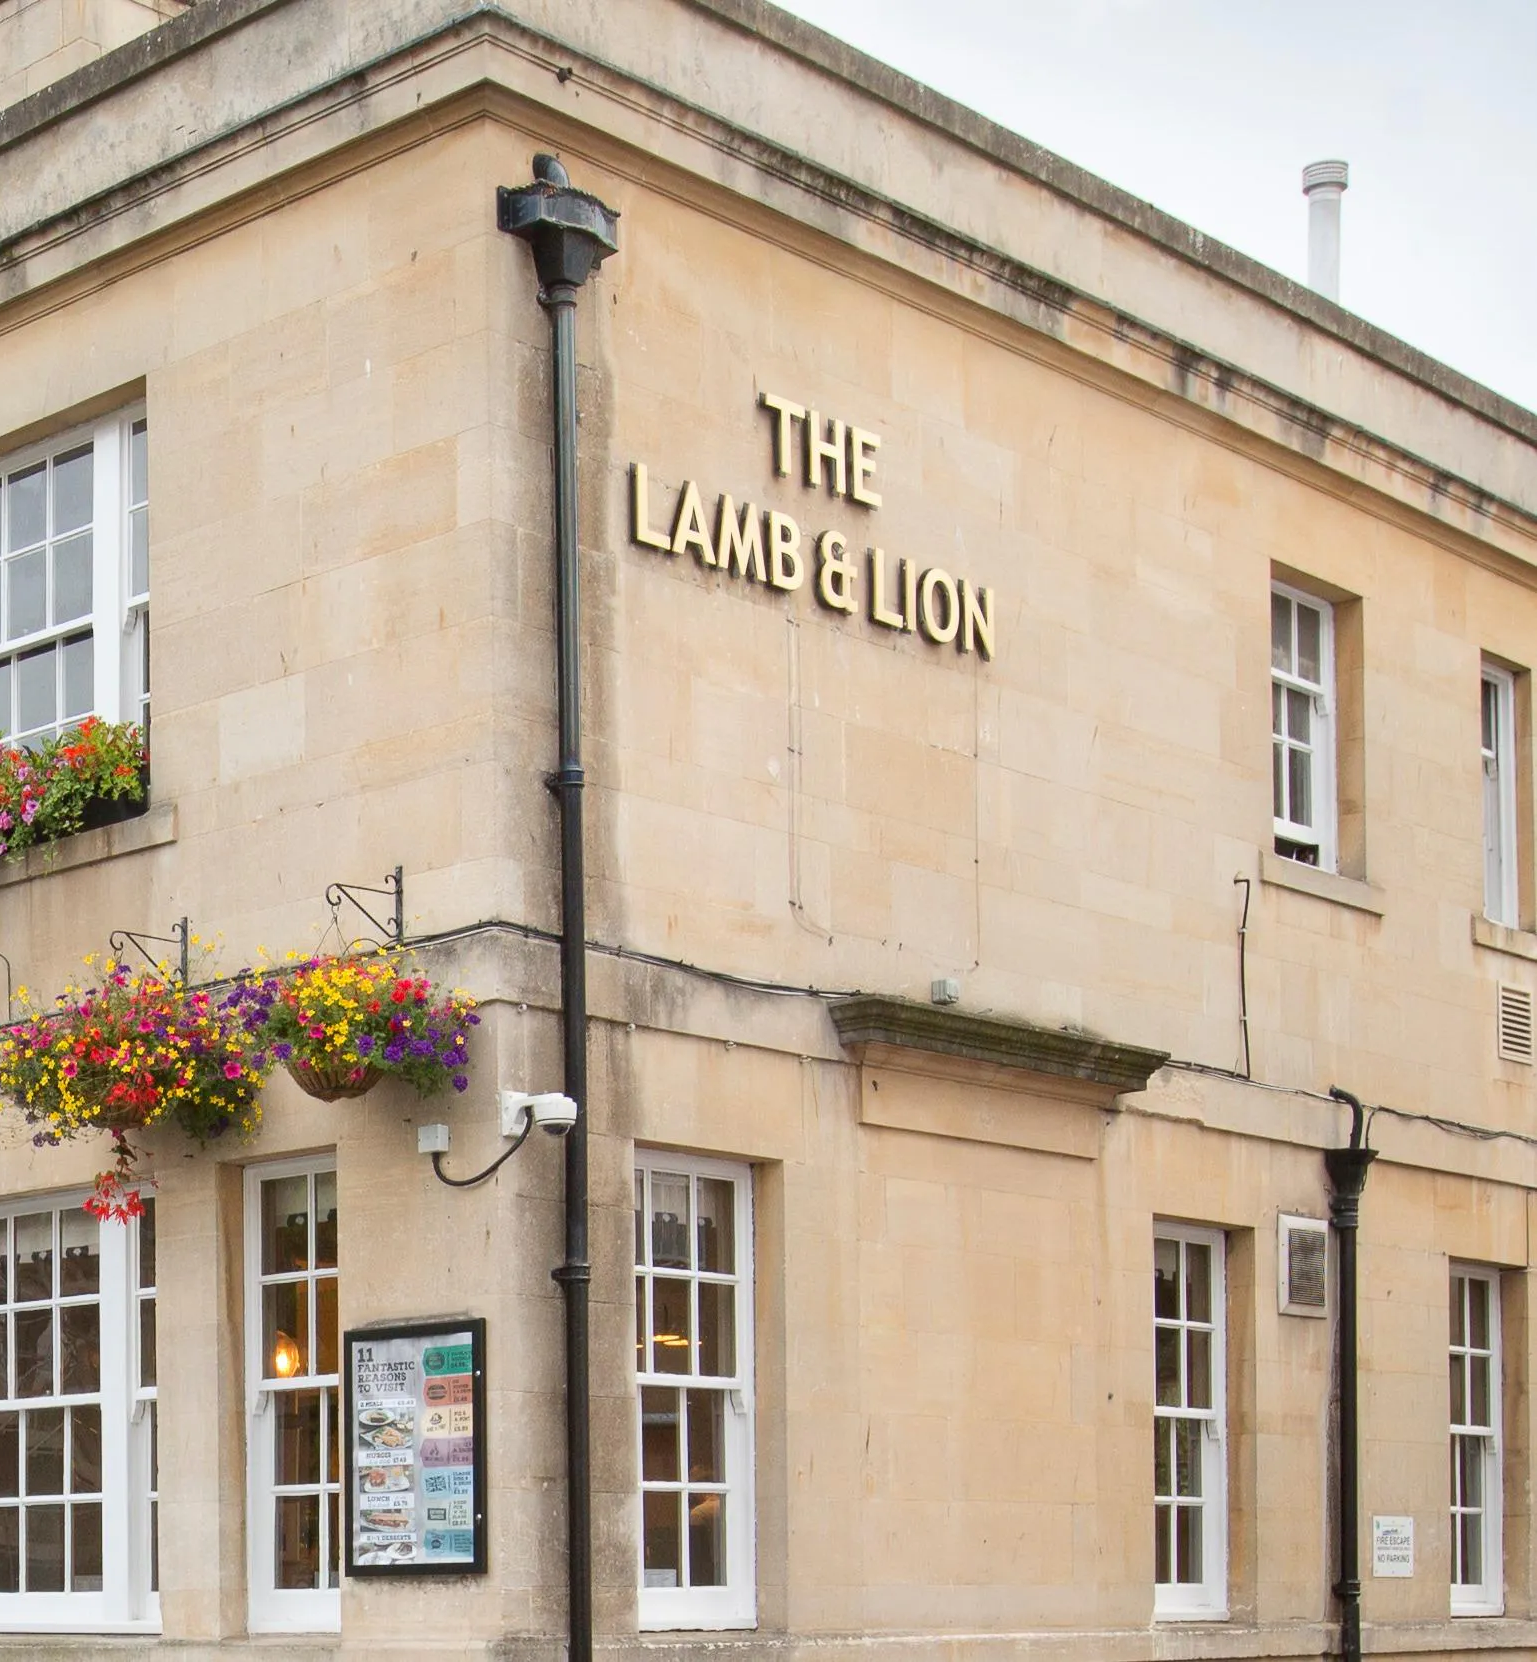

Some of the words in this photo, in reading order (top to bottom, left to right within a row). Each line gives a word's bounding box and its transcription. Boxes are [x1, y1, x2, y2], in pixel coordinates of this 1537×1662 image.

[760, 391, 882, 510] THE
[630, 461, 804, 592] LAMB
[817, 529, 859, 615] &
[868, 546, 995, 662] LION
[357, 1347, 374, 1363] 11
[357, 1361, 415, 1373] FANTASTIC
[357, 1371, 407, 1384] REASONS
[357, 1383, 371, 1393] TO
[375, 1382, 405, 1392] VISIT
[1376, 1536, 1389, 1546] FIRE
[1389, 1536, 1411, 1546] ESCAPE
[1377, 1553, 1385, 1563] NO
[1386, 1553, 1410, 1563] PARKING
